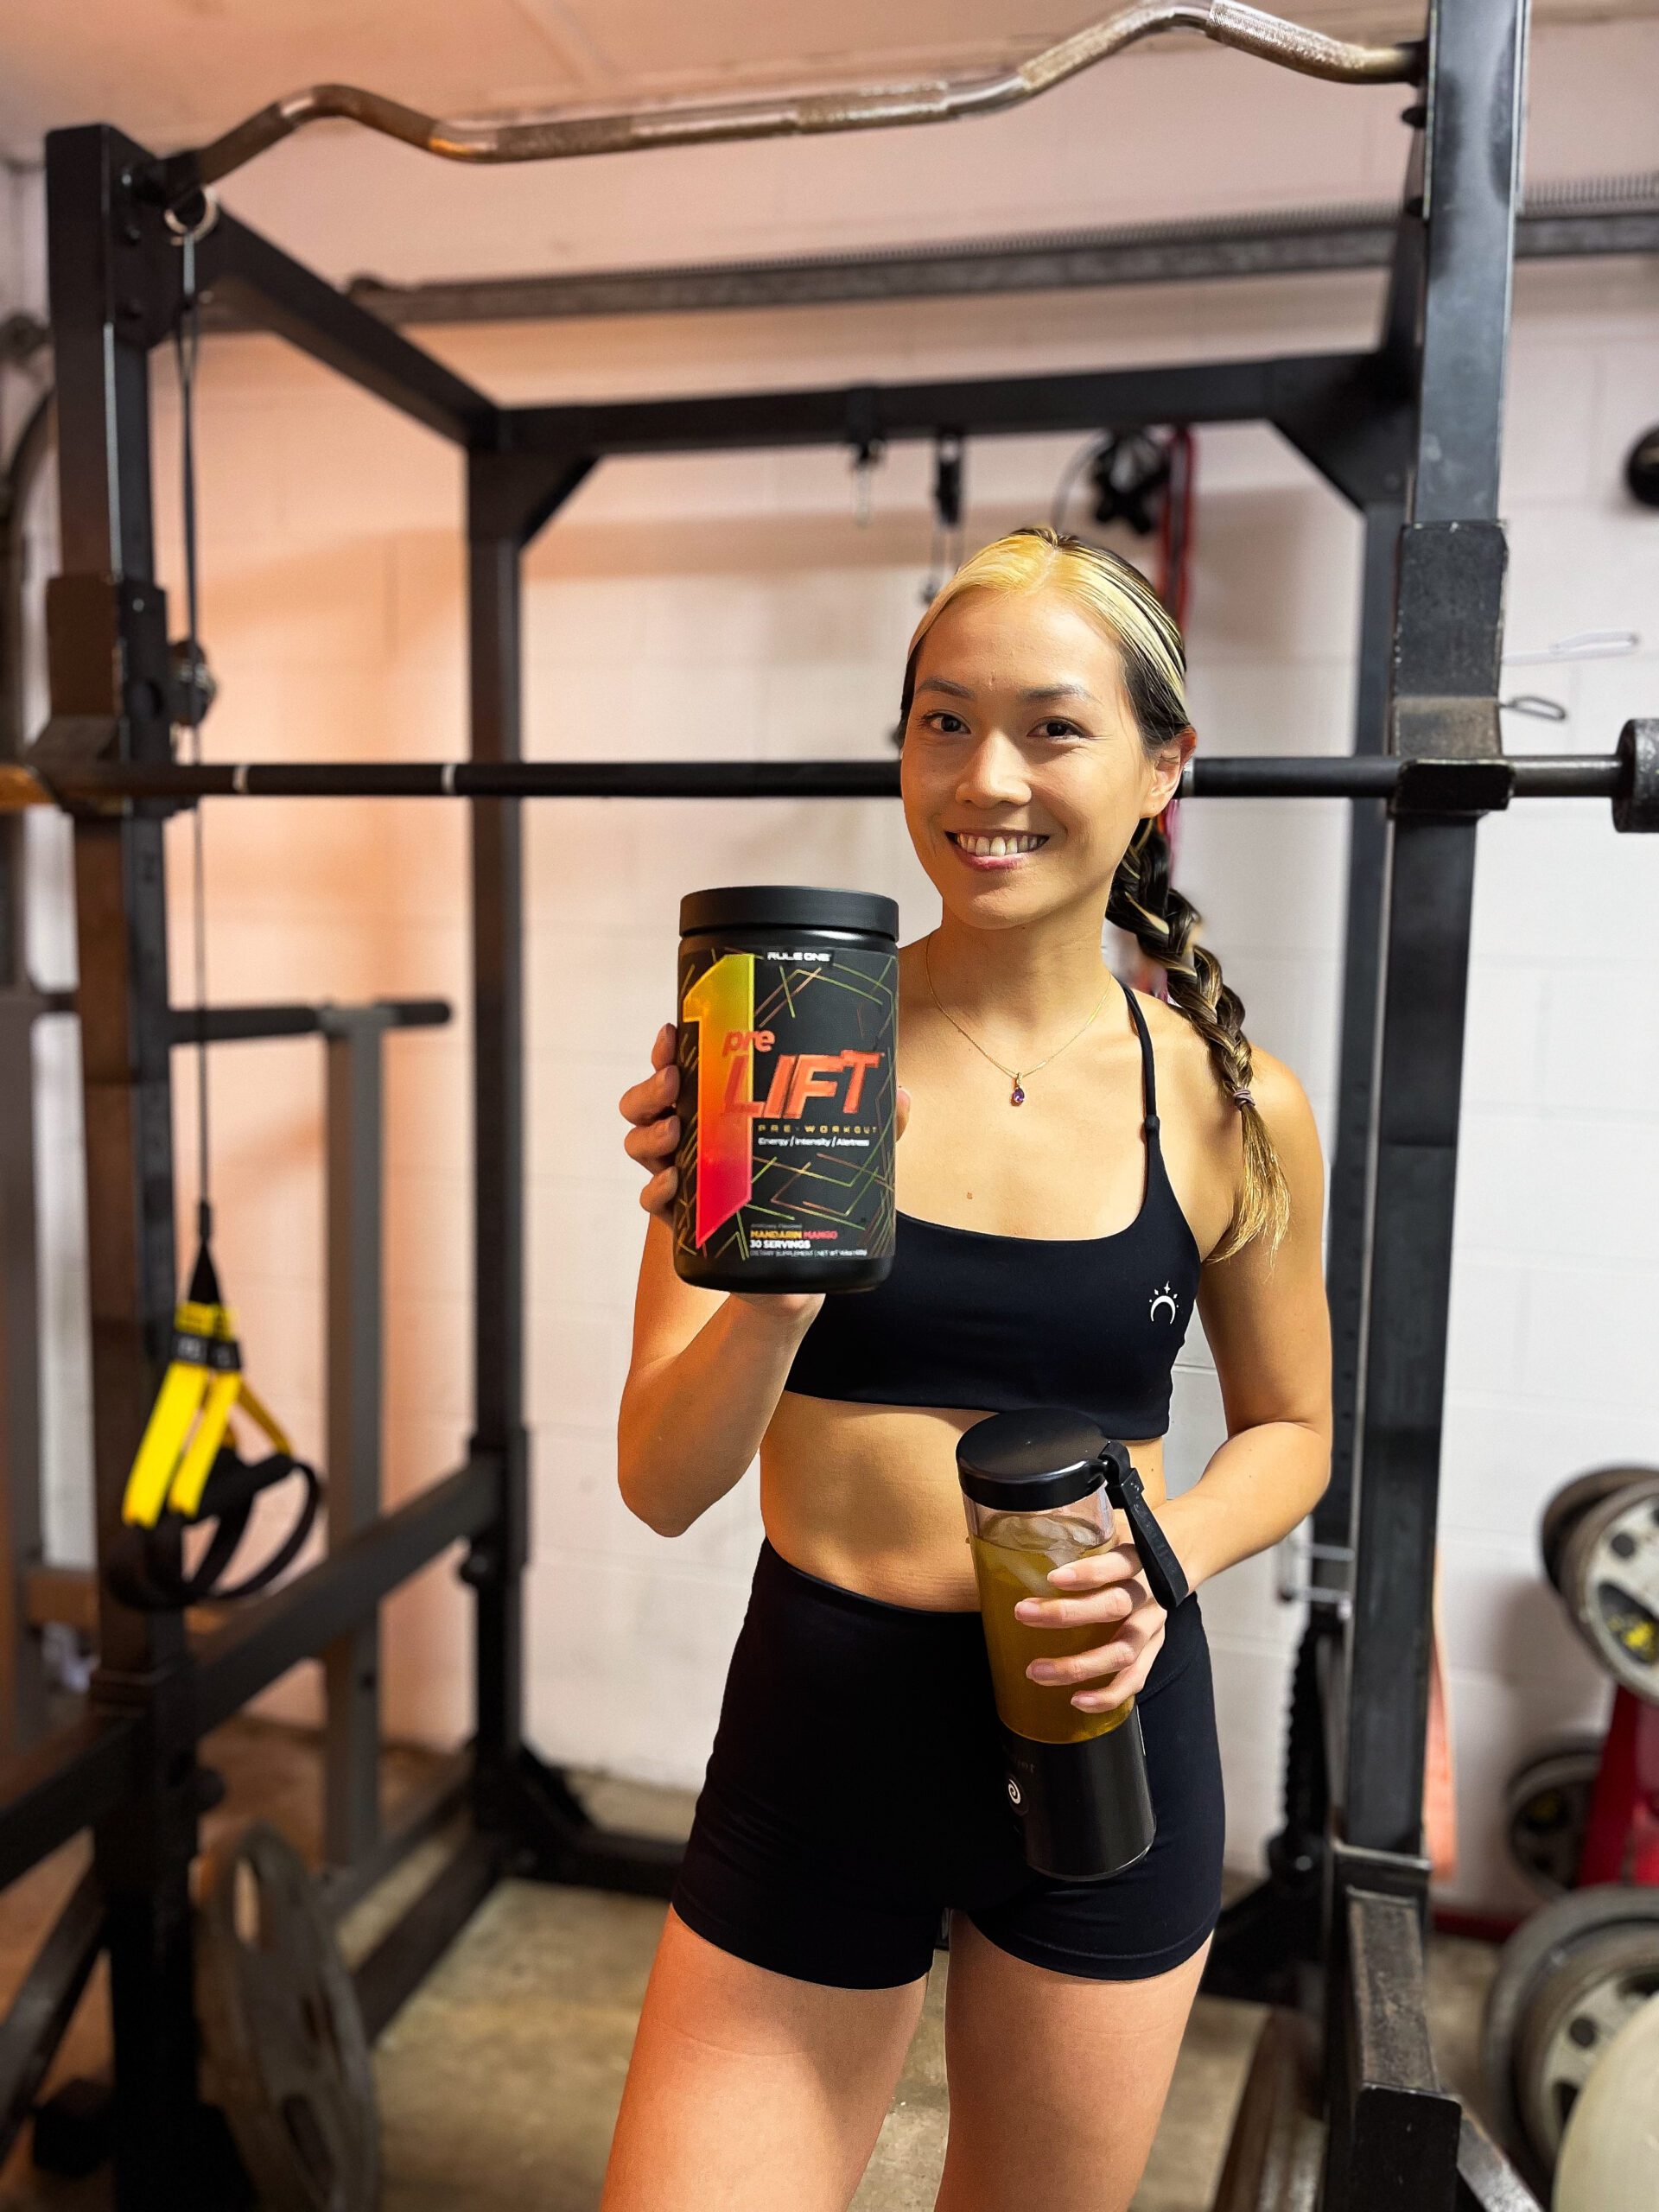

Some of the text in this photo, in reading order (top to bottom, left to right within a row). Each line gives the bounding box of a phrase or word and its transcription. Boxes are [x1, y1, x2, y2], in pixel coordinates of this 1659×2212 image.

[767, 952, 830, 962] RULE ONE
[722, 1030, 775, 1057] pre
[722, 1050, 880, 1119] LIFT
[751, 1230, 838, 1239] MANDARIN MANGO
[750, 1239, 811, 1249] 30 SERVINGS
